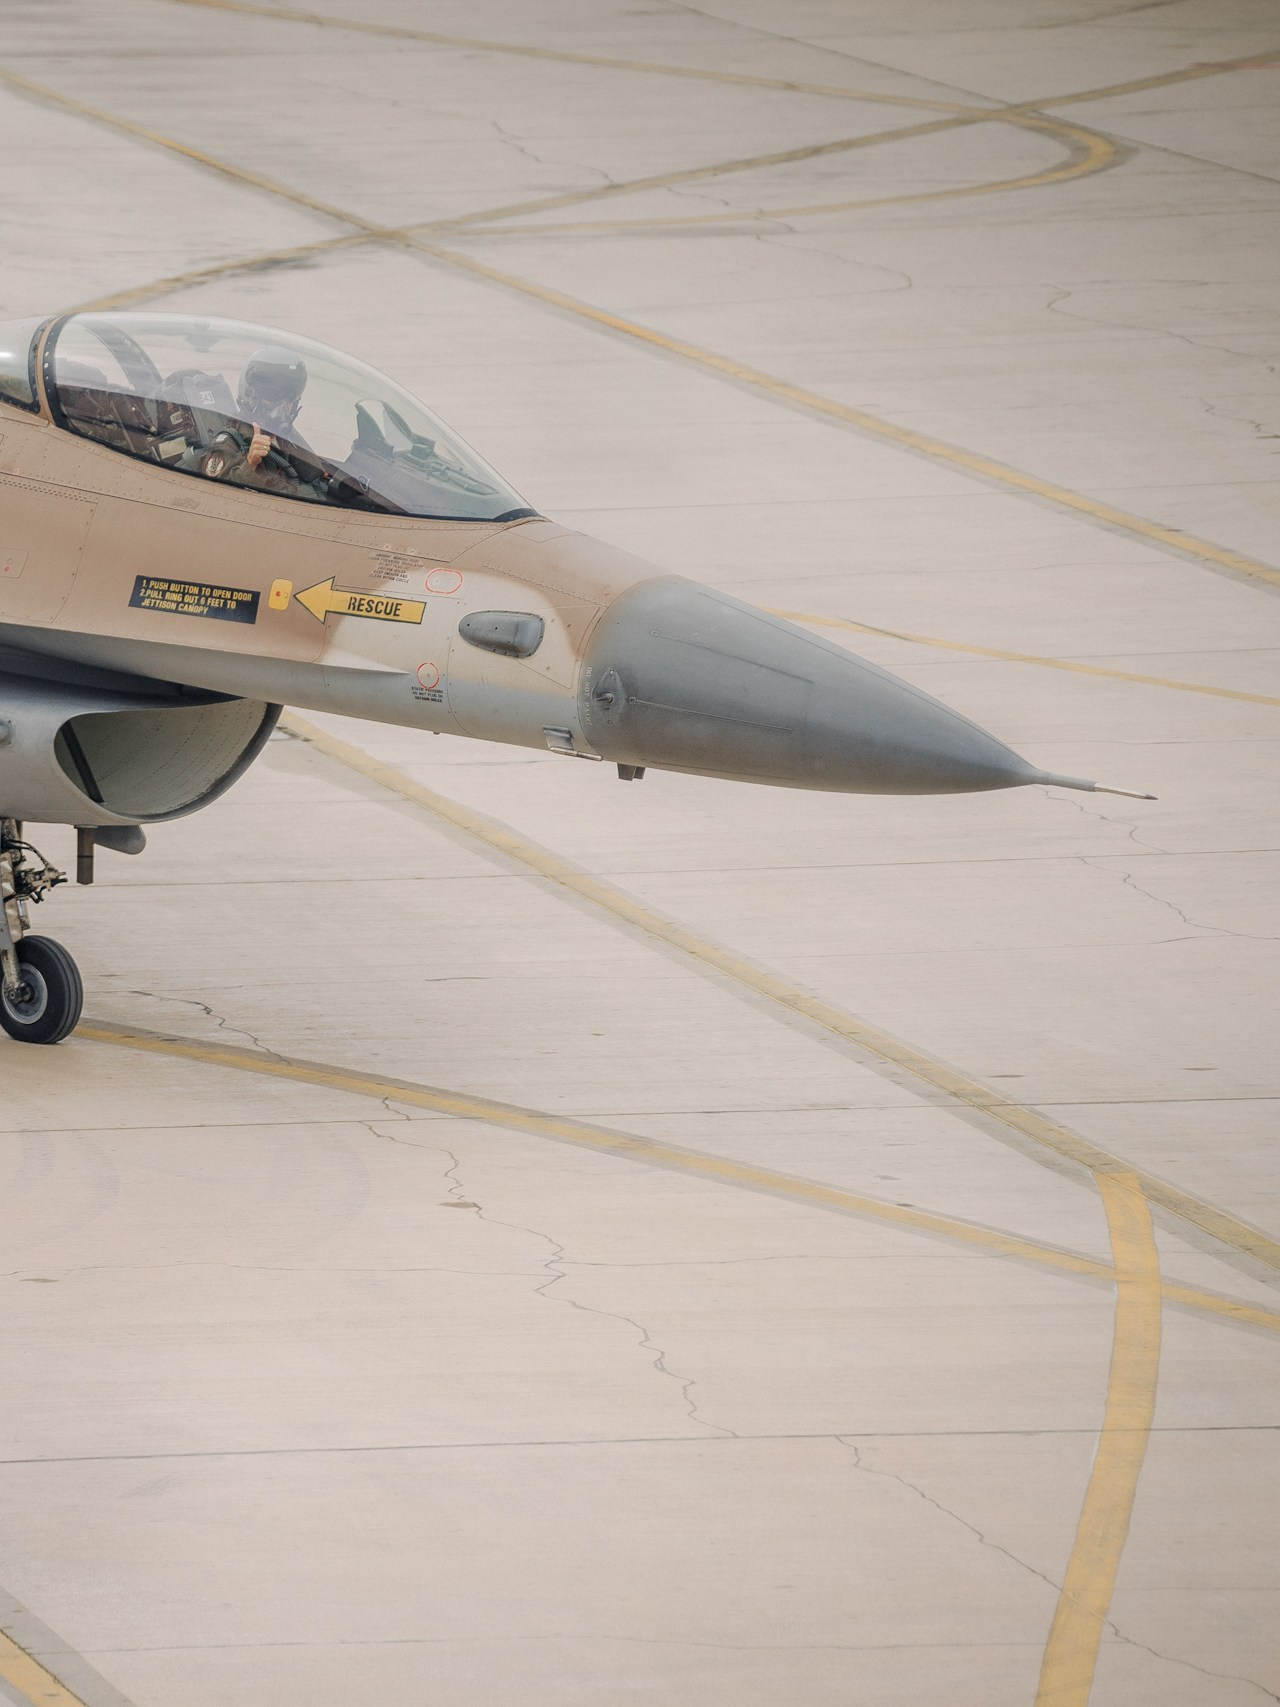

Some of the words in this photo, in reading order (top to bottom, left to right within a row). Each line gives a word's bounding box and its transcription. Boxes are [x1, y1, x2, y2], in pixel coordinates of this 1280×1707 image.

[149, 580, 168, 589] PUSH
[170, 583, 199, 595] BUTTON
[201, 587, 211, 595] TO
[212, 589, 232, 599] OPEN
[232, 592, 253, 602] DOOR
[165, 591, 182, 602] RING
[184, 594, 198, 605] OUT
[200, 596, 205, 605] 6
[207, 597, 224, 608] FEET
[227, 600, 236, 609] TO
[141, 598, 177, 610] JETTISON
[178, 602, 209, 615] CANOPY
[347, 596, 403, 617] RESCUE
